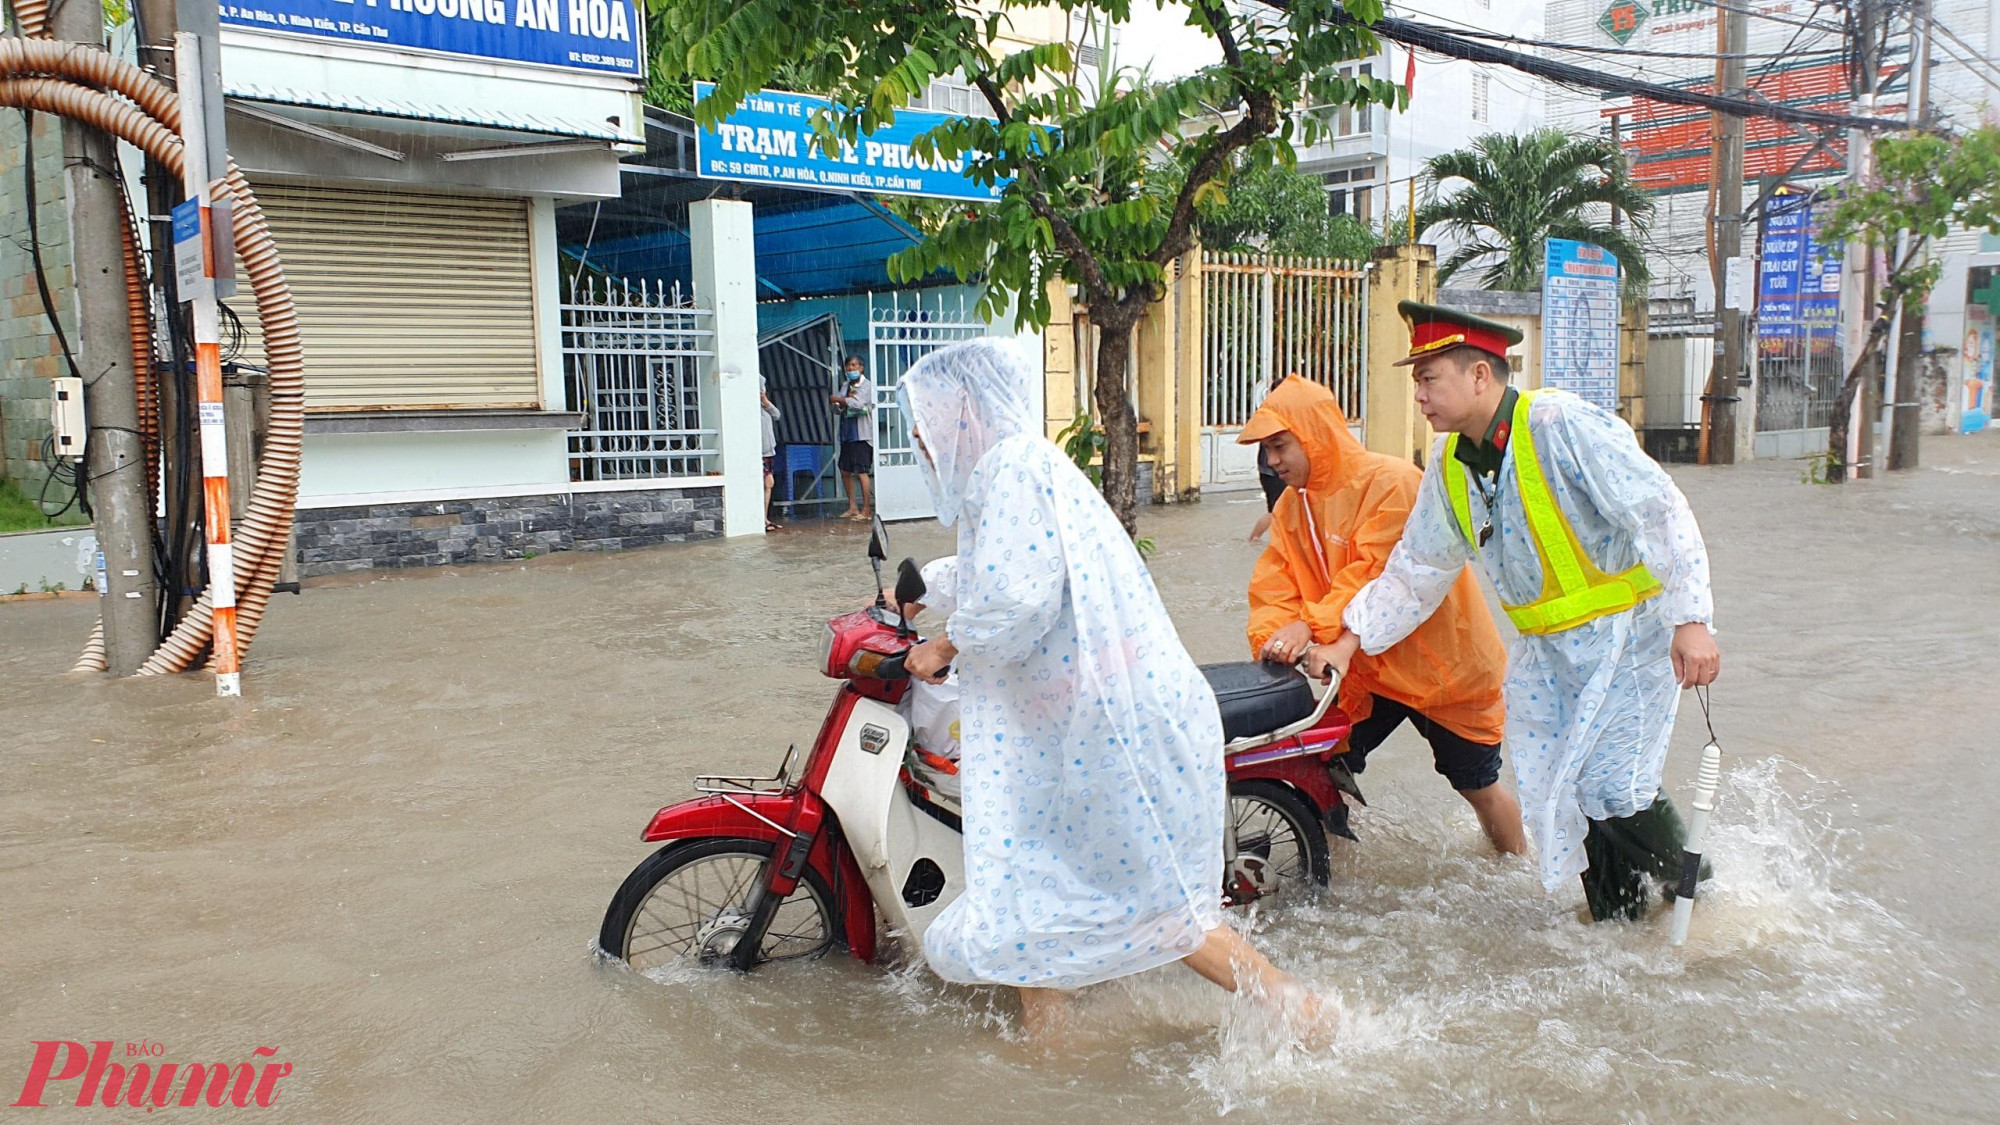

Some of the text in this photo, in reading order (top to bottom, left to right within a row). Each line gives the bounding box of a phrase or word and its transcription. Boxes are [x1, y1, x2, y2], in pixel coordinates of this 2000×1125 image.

[241, 8, 254, 20] An
[290, 14, 313, 28] Ninh
[516, 0, 560, 32] AN
[749, 97, 775, 114] TÂM
[777, 102, 784, 115] Y
[787, 101, 801, 117] TẾ
[717, 122, 798, 161] TRẠM
[729, 161, 742, 174] 59
[743, 163, 772, 179] CMT8,
[773, 165, 796, 180] P.AN
[796, 166, 818, 183] HÒA,
[820, 170, 850, 185] Q.NINH
[905, 178, 922, 191] THƠ
